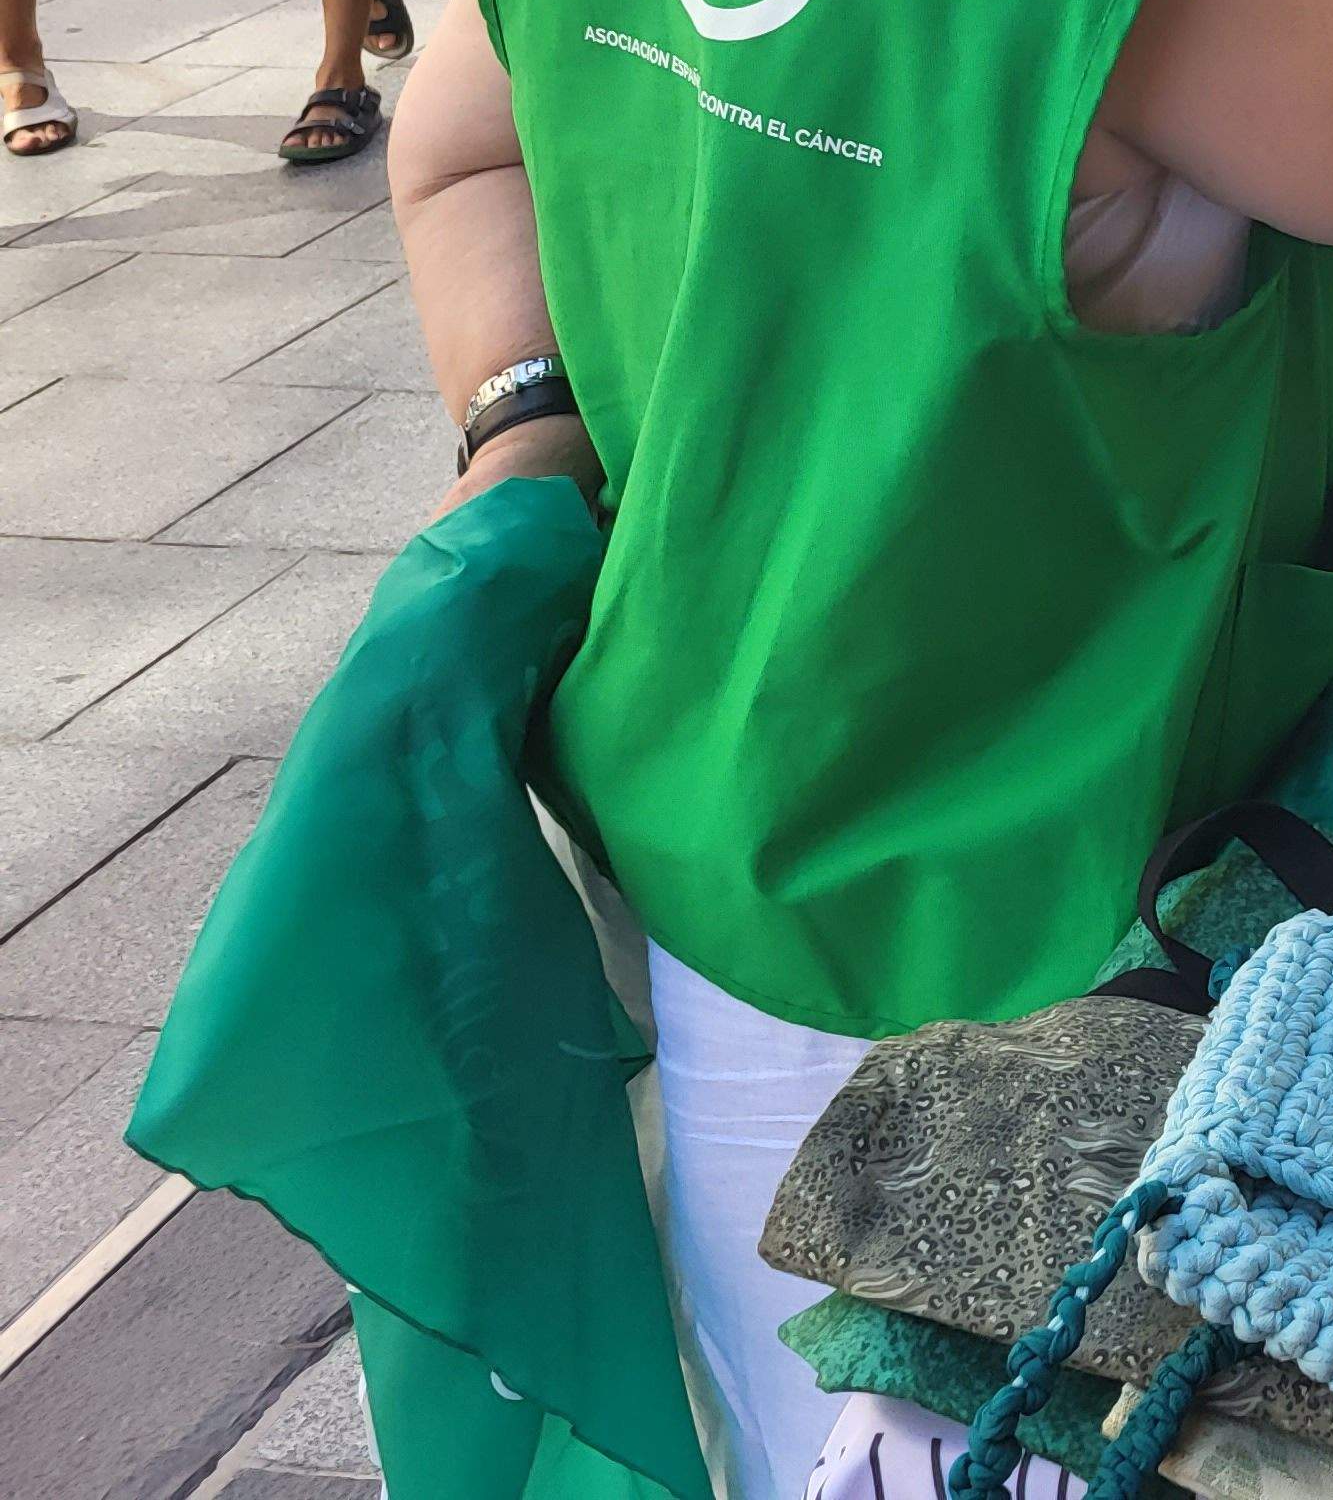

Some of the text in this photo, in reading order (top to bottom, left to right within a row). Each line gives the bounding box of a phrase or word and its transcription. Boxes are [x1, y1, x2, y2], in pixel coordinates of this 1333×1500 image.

[584, 25, 671, 69] ASOCIACIÓN
[699, 90, 883, 167] CONTRA EL CÁNCER
